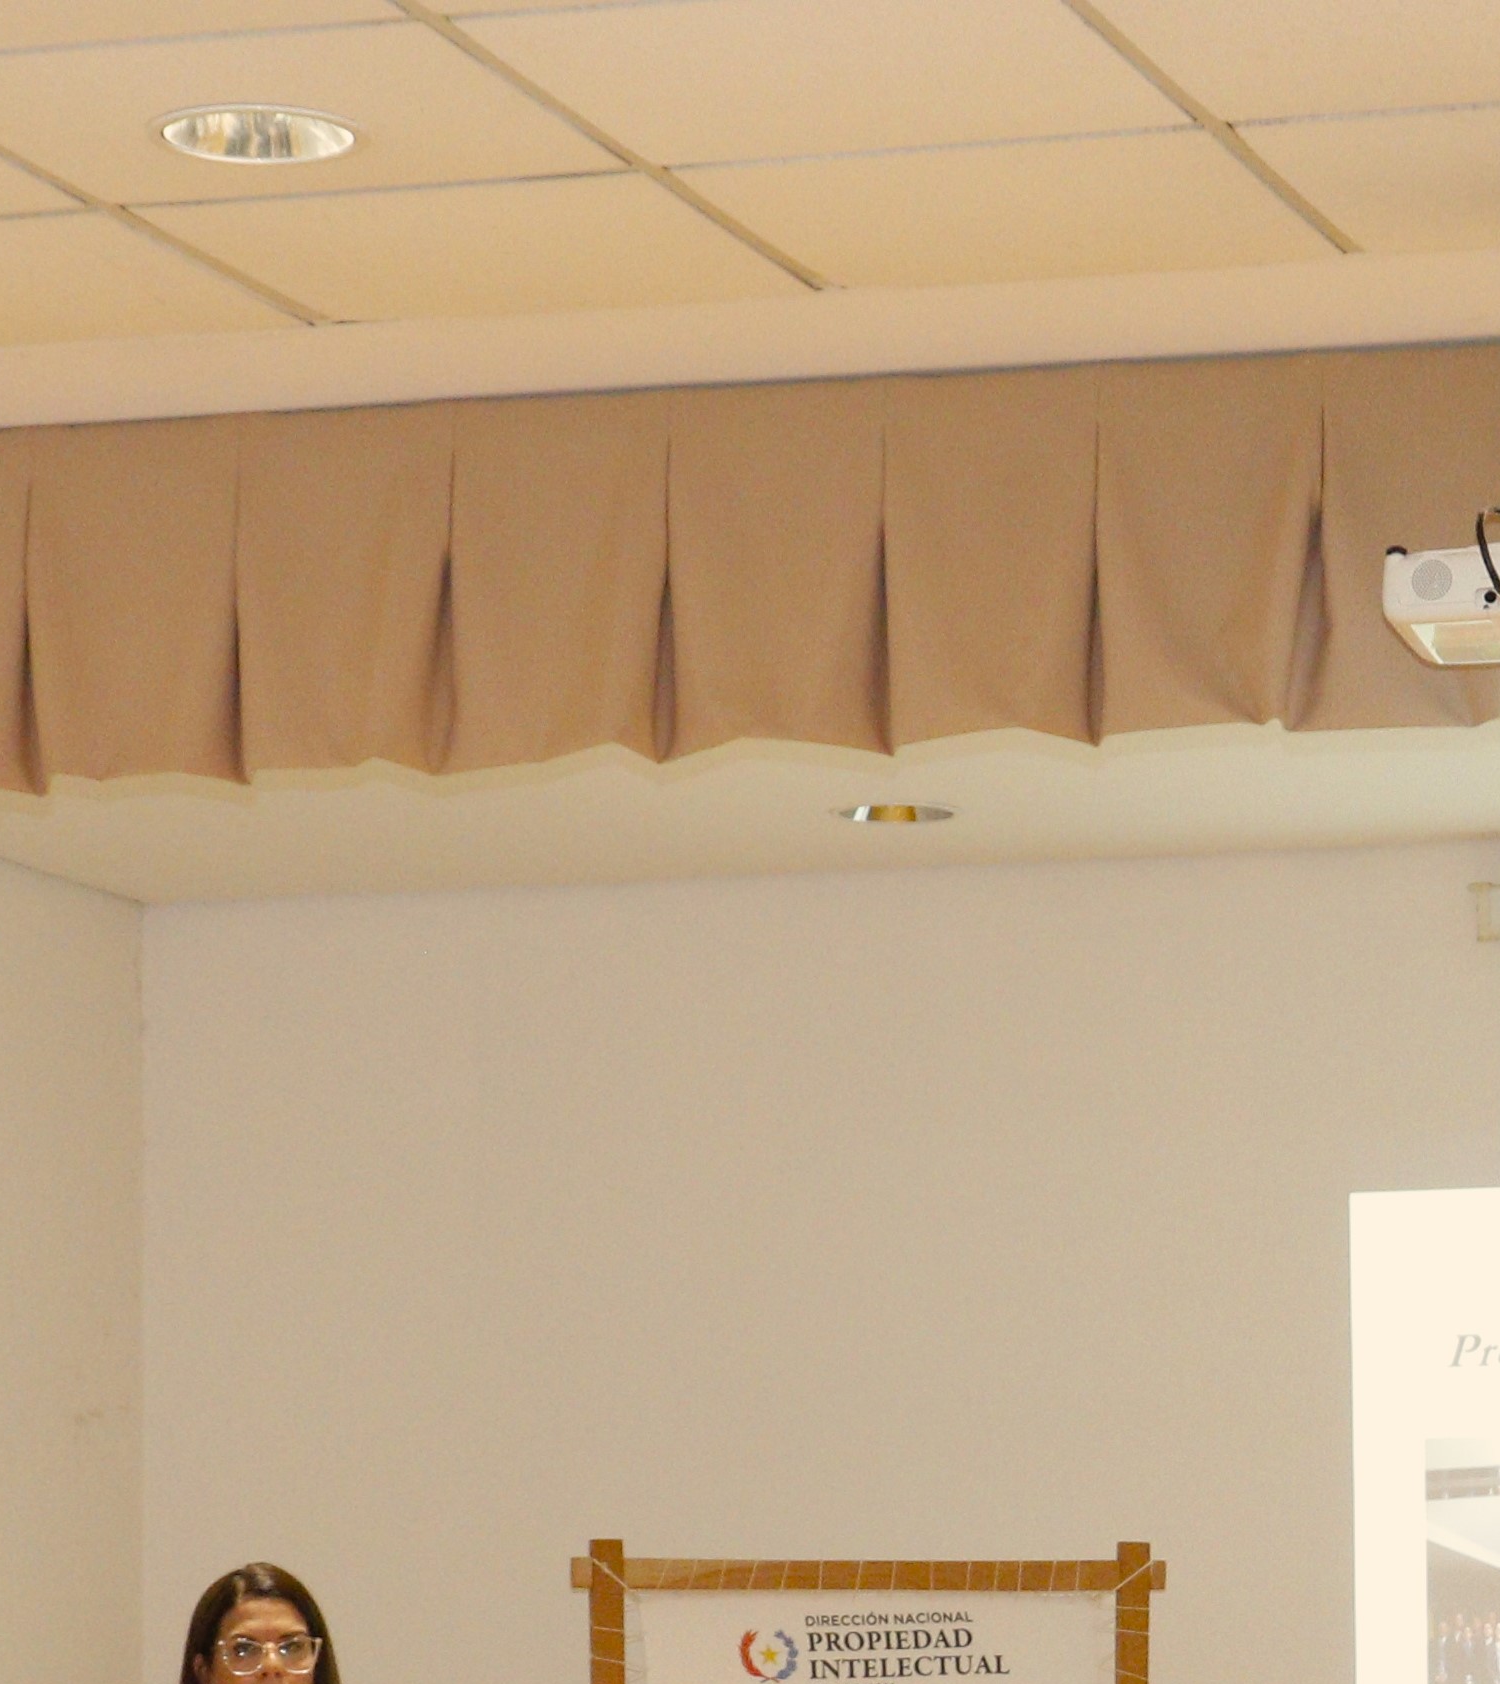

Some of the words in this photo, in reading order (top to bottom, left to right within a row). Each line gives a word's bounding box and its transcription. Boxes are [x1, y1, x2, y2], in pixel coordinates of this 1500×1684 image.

[805, 1611, 888, 1627] DIRECCIÓN
[894, 1611, 973, 1625] NACIONAL
[806, 1628, 973, 1651] PROPIEDAD
[809, 1655, 1010, 1680] INTELECTUAL
